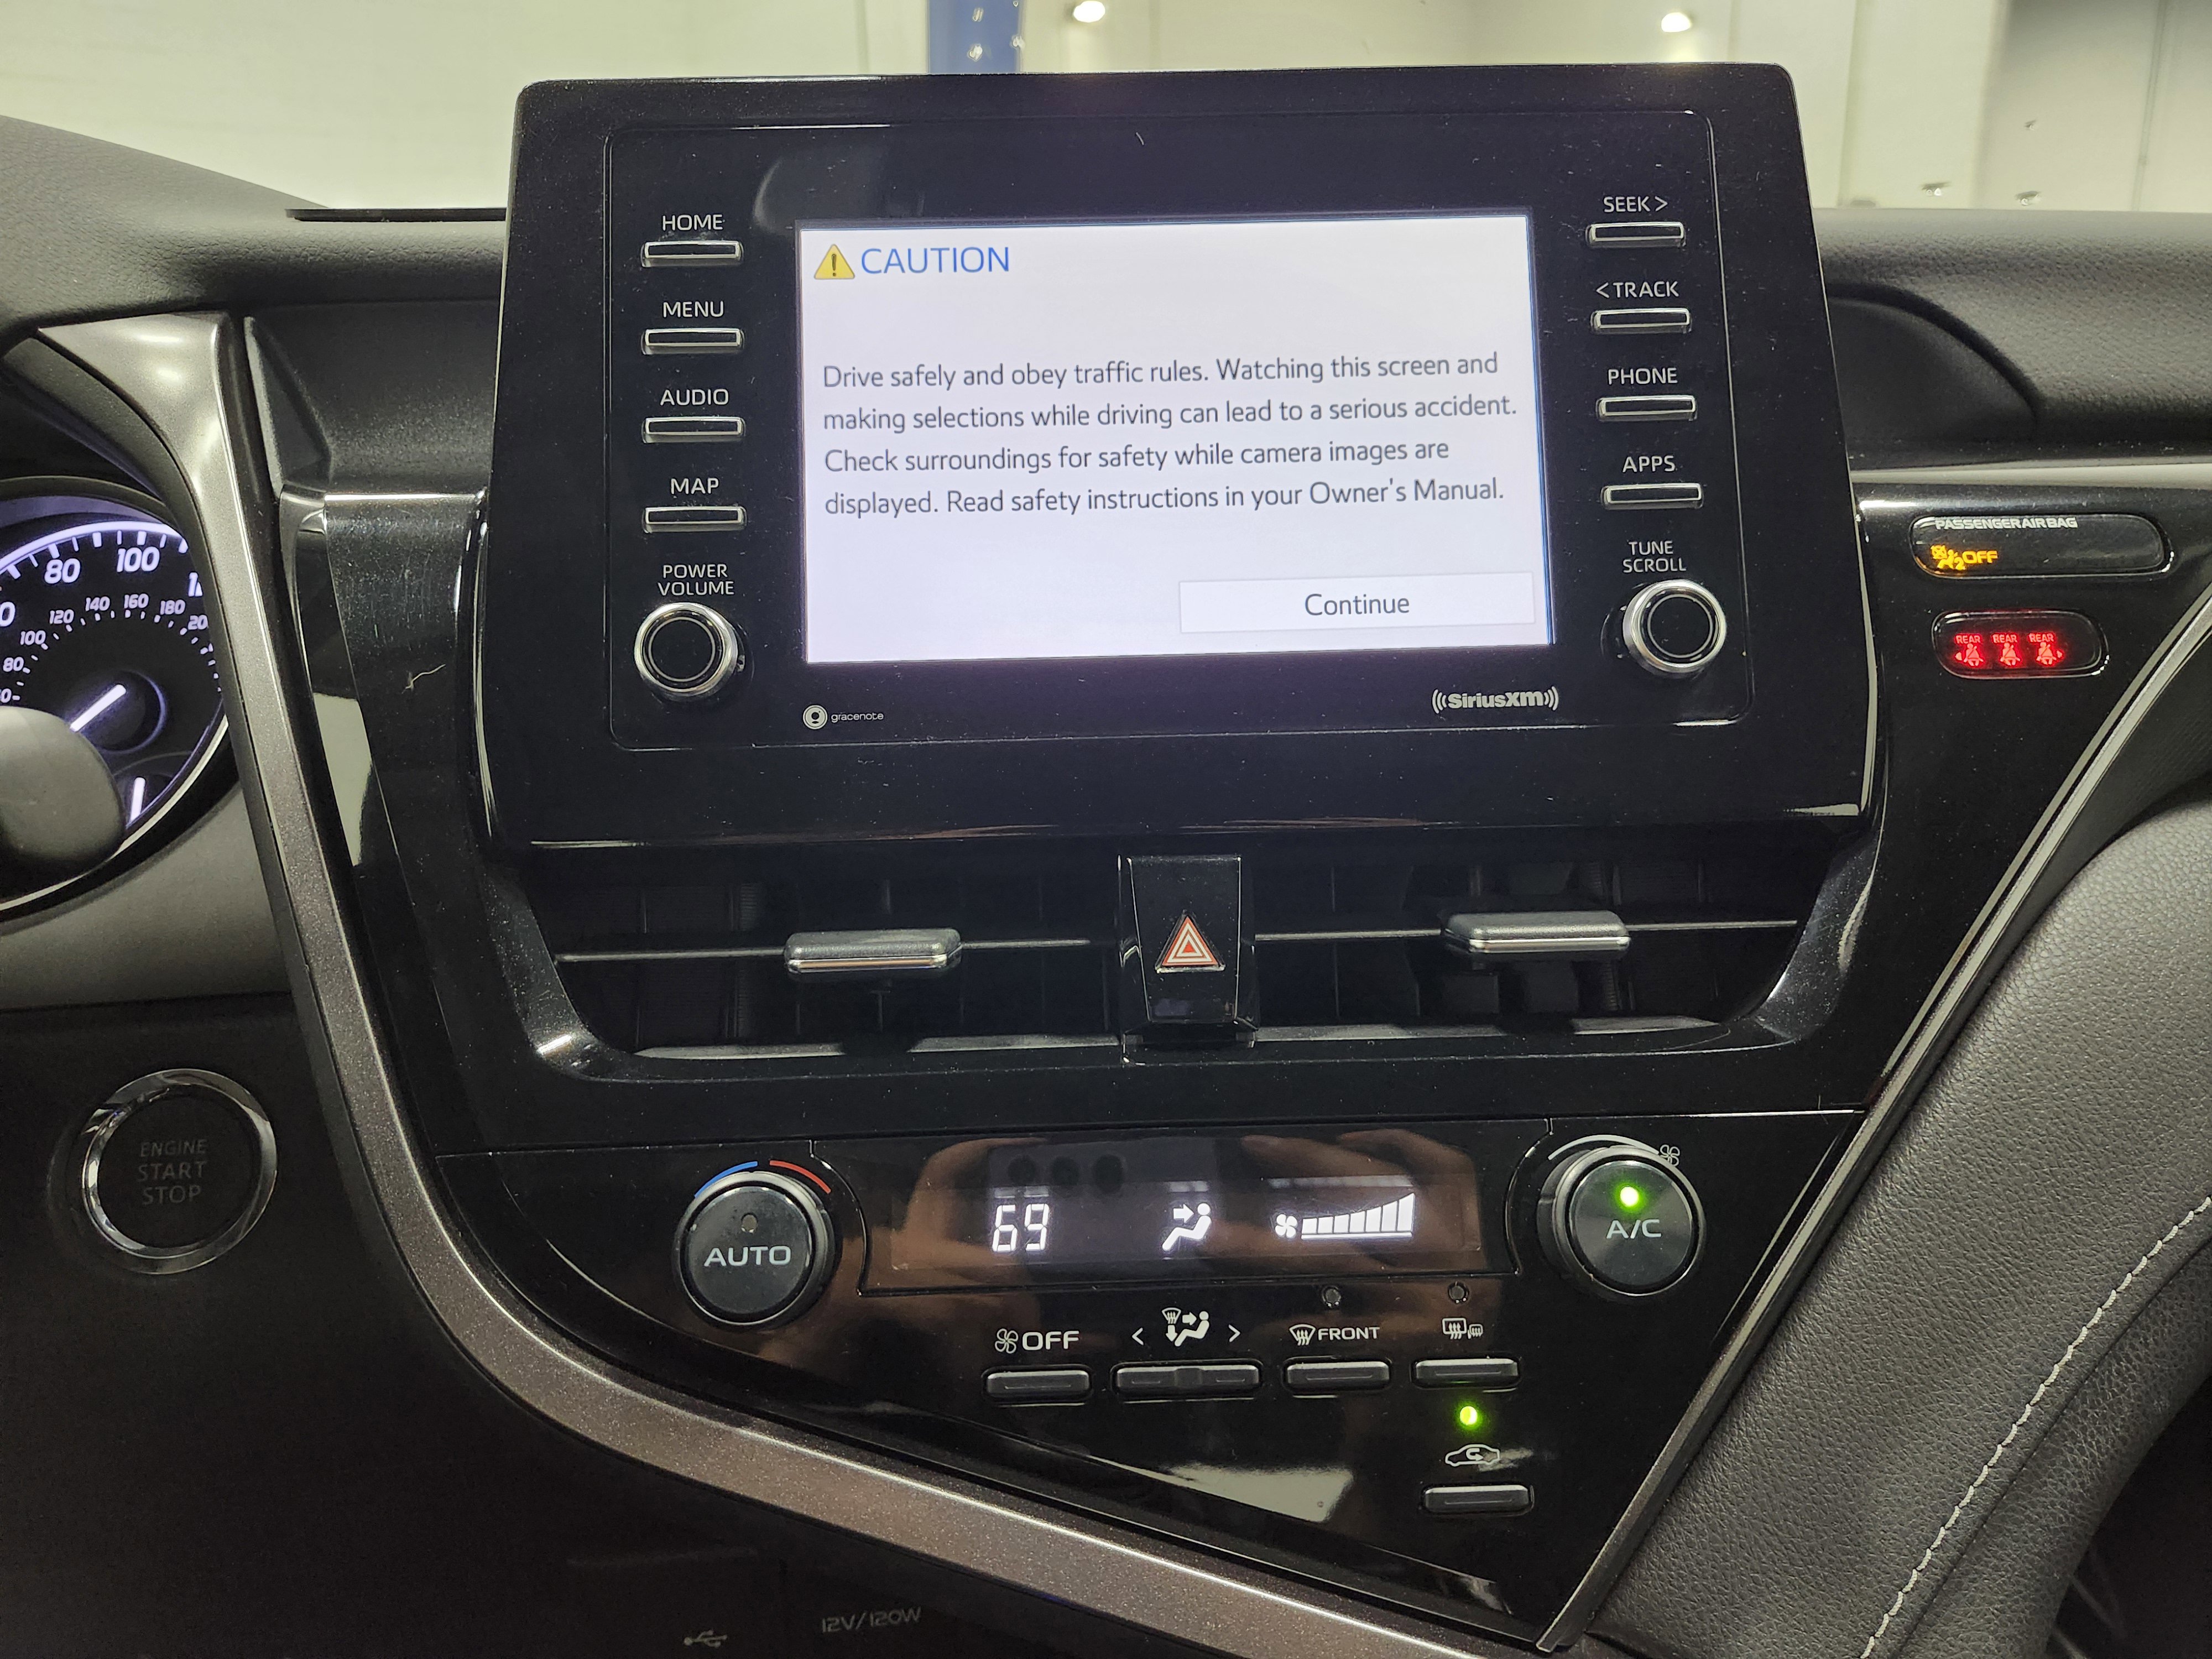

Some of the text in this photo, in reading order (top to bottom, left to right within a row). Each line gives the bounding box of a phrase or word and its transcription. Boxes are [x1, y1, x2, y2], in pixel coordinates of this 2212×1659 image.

[1603, 196, 1651, 212] SEEK
[662, 214, 723, 231] HOME
[861, 247, 1009, 274] CAUTION
[1613, 281, 1679, 298] TRACK
[663, 300, 724, 318] MENU
[824, 351, 1498, 391] Drive safely and obey traffic rules. Watching this screen and
[1608, 367, 1678, 385] PHONE
[660, 388, 729, 406] AUDIO
[824, 393, 1516, 434] making selections while driving can lead to a serious accident.
[825, 441, 1449, 474] Check surroundings for safety while camera images are
[1623, 455, 1676, 473] APPS
[671, 478, 719, 494] MAP
[825, 477, 1504, 519] displayed. Read safety instructions in your Owner's Manual.
[1936, 518, 2021, 530] PASSENGER
[1628, 540, 1673, 555] TUNE
[117, 546, 160, 572] 100
[1623, 558, 1687, 573] SCROLL
[1961, 551, 1998, 564] OFF
[44, 558, 81, 584] 80
[663, 564, 728, 578] POWER
[658, 581, 734, 596] VOLUME
[86, 596, 110, 611] 140
[124, 593, 149, 609] 160
[160, 599, 186, 615] 180
[1305, 593, 1410, 616] Continue
[49, 609, 74, 624] 120
[20, 630, 46, 645] 100
[1956, 635, 1981, 644] REAR
[1992, 634, 2017, 643] REAR
[2029, 633, 2054, 642] REAR
[3, 657, 24, 672] 80
[831, 712, 884, 723] gracenote
[140, 1139, 207, 1157] ENGINE
[137, 1161, 207, 1182] START
[142, 1185, 201, 1206] STOP
[992, 1203, 1050, 1253] 69
[1606, 1219, 1662, 1239] A/C
[703, 1245, 791, 1267] AUTO
[1022, 1331, 1079, 1350] OFF
[1318, 1327, 1380, 1340] FRONT
[822, 1606, 921, 1632] 12V/120W
